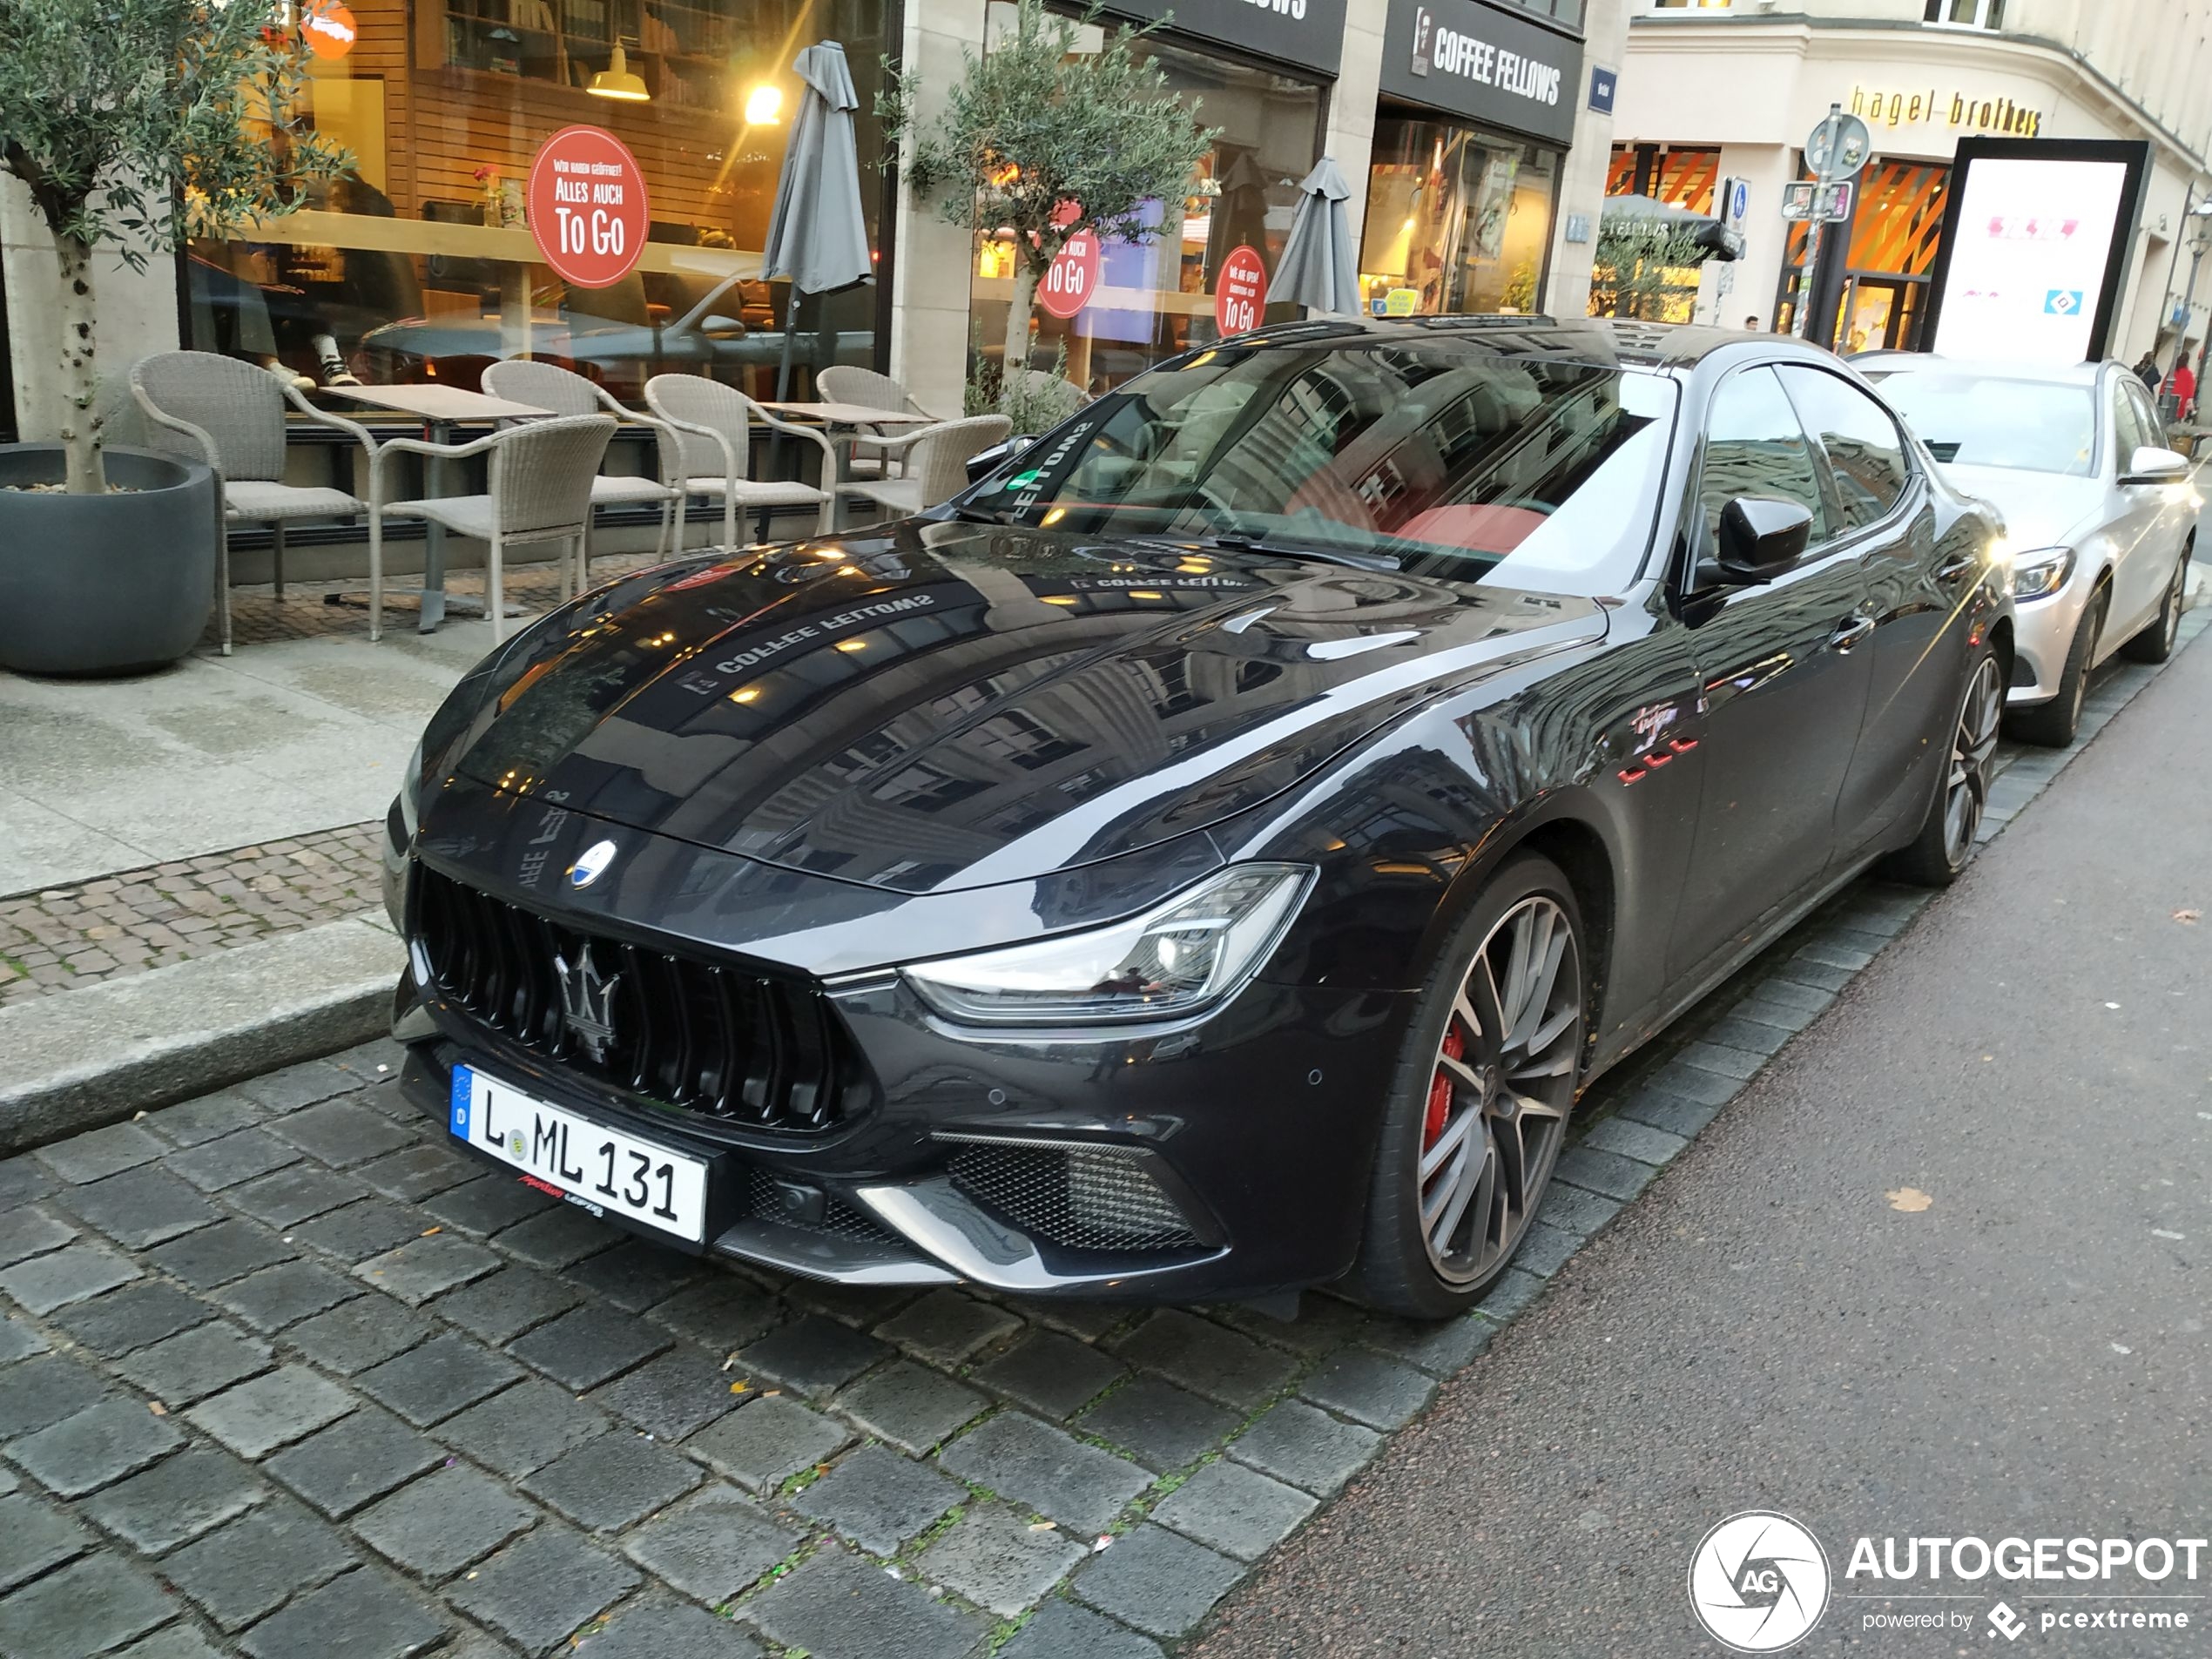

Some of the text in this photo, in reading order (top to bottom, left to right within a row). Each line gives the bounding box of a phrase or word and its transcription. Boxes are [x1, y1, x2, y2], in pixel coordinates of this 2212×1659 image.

[1433, 27, 1561, 106] COFFEE FELLOWS
[1950, 91, 2041, 137] brothers
[555, 177, 624, 205] ALLES AUCH
[485, 1089, 678, 1222] L ML 131
